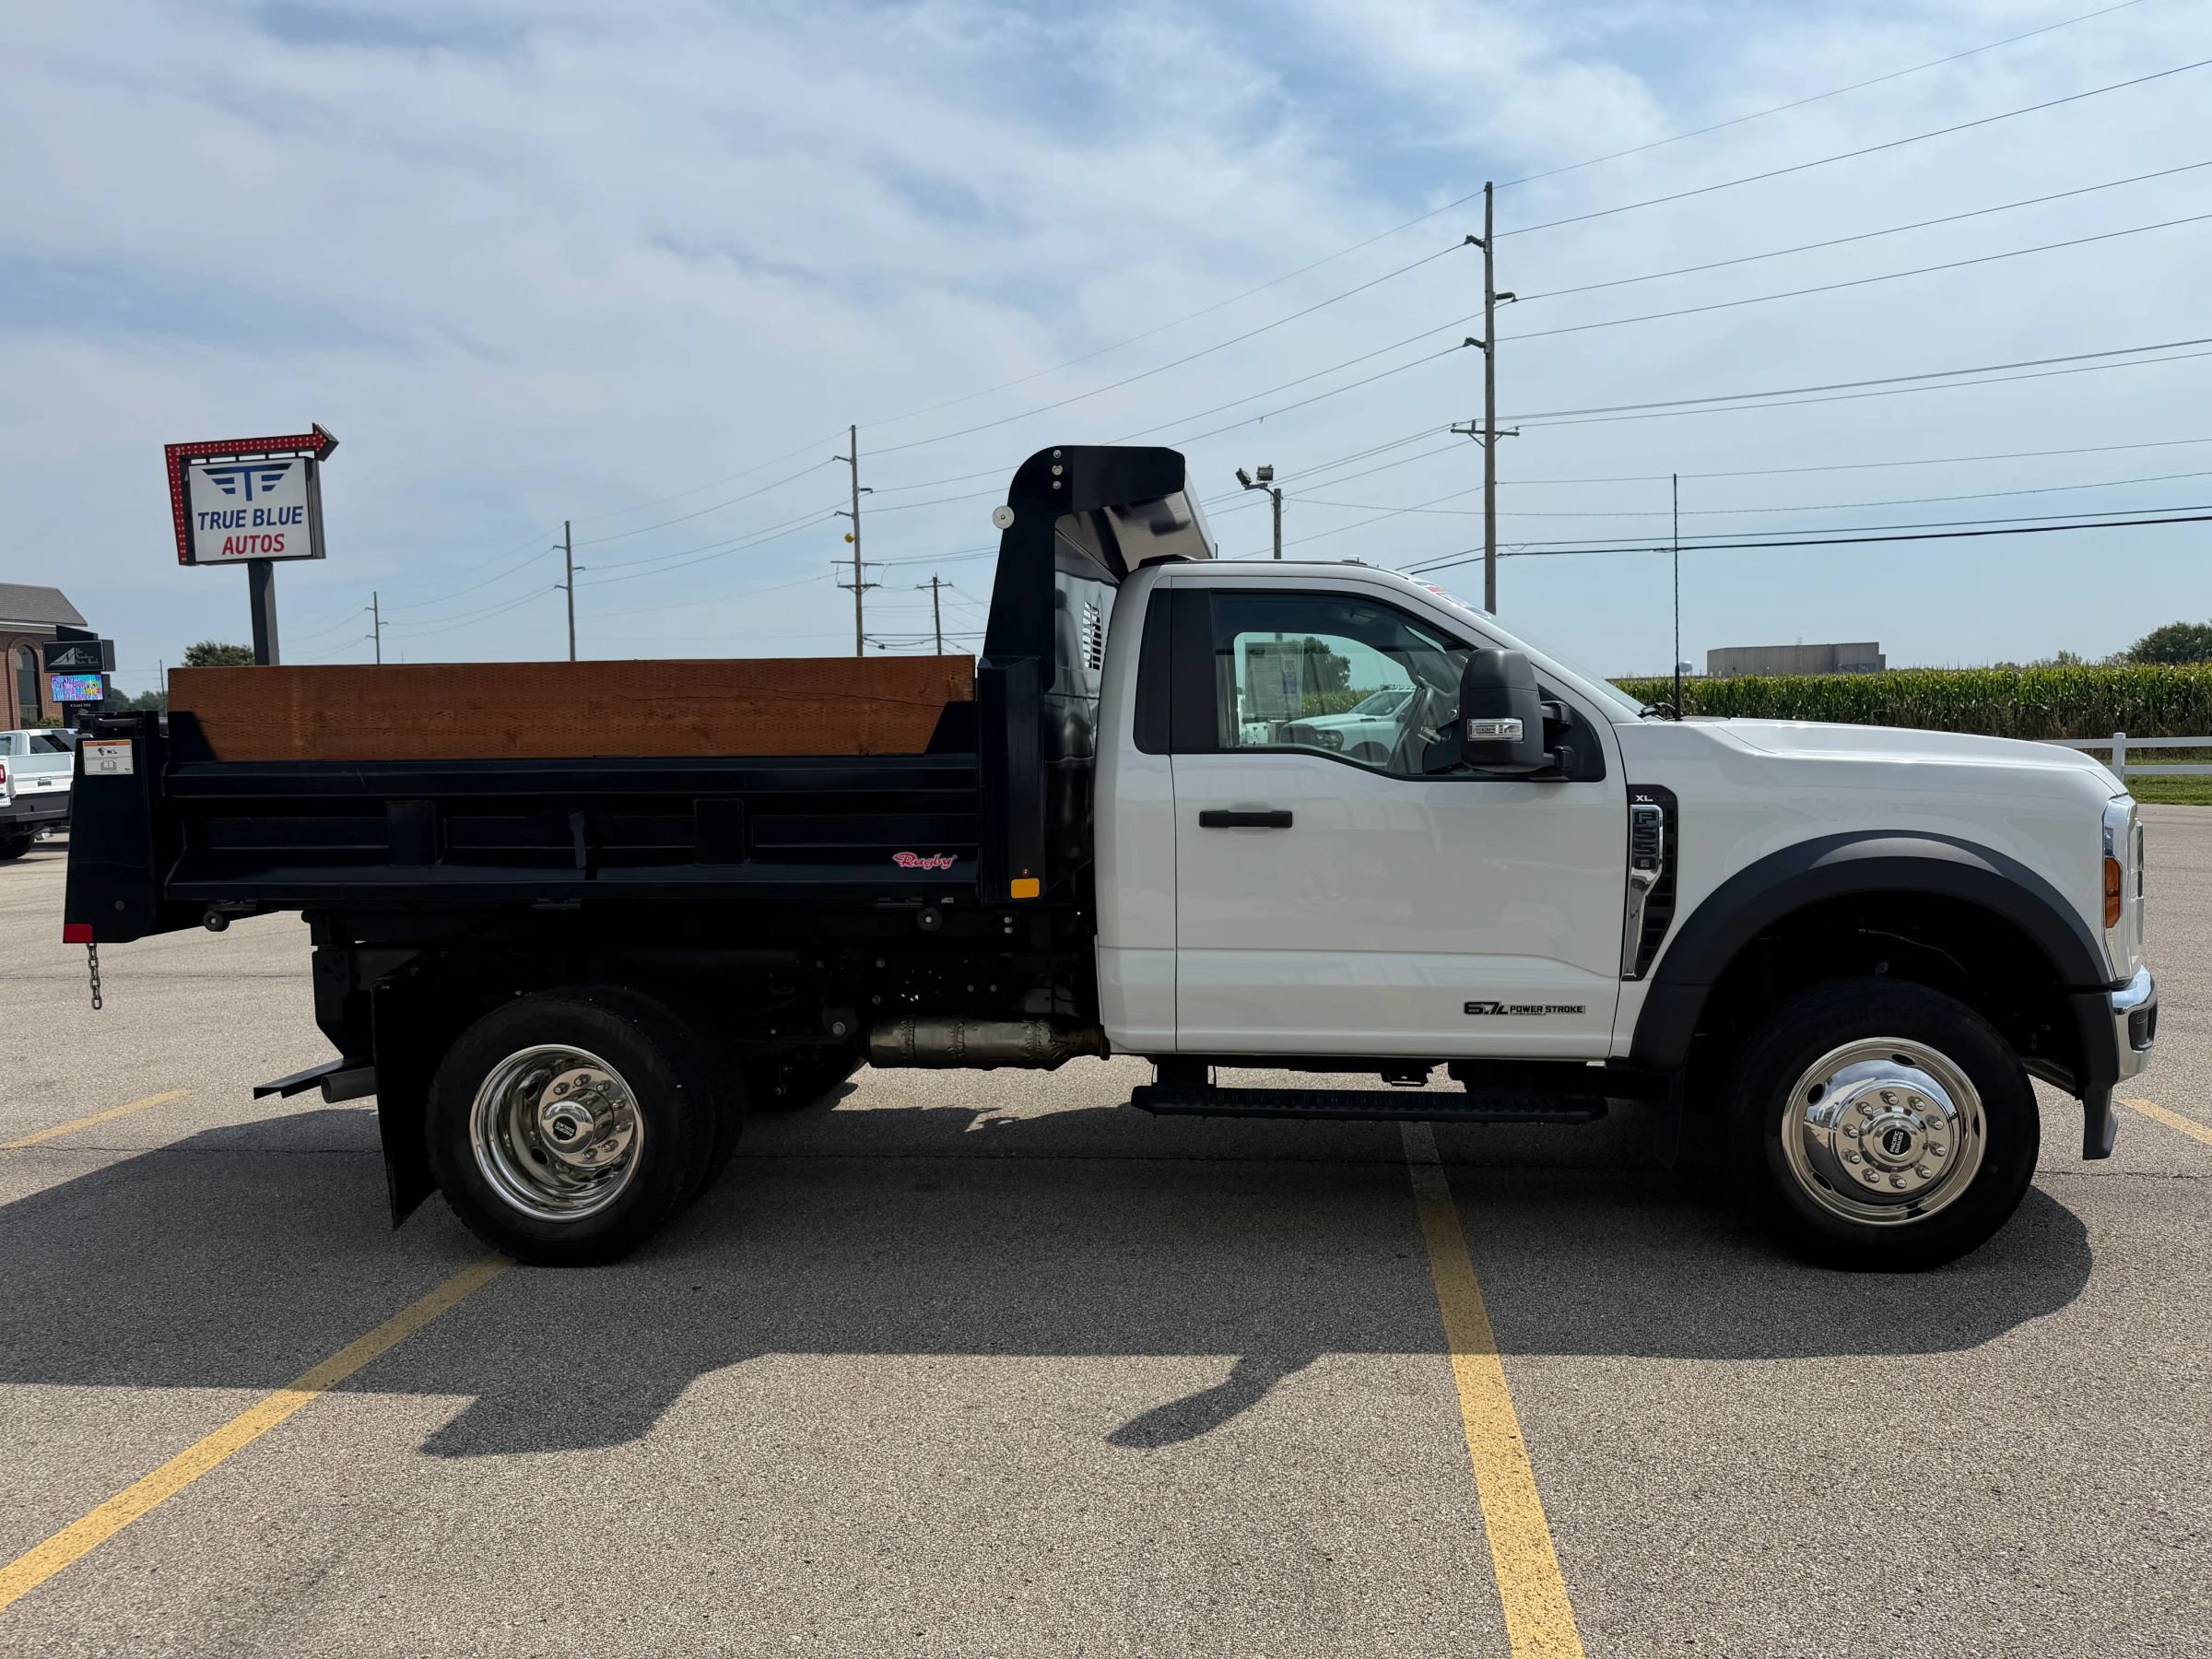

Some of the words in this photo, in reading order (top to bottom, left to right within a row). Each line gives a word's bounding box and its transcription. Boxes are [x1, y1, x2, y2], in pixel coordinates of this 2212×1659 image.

[197, 509, 247, 531] TRUE
[253, 505, 304, 527] BLUE
[221, 533, 286, 556] AUTOS
[892, 852, 959, 870] Rugby
[1464, 1001, 1509, 1015] 6.7L
[1510, 1005, 1543, 1013] POWER
[1545, 1005, 1583, 1013] STROKE
